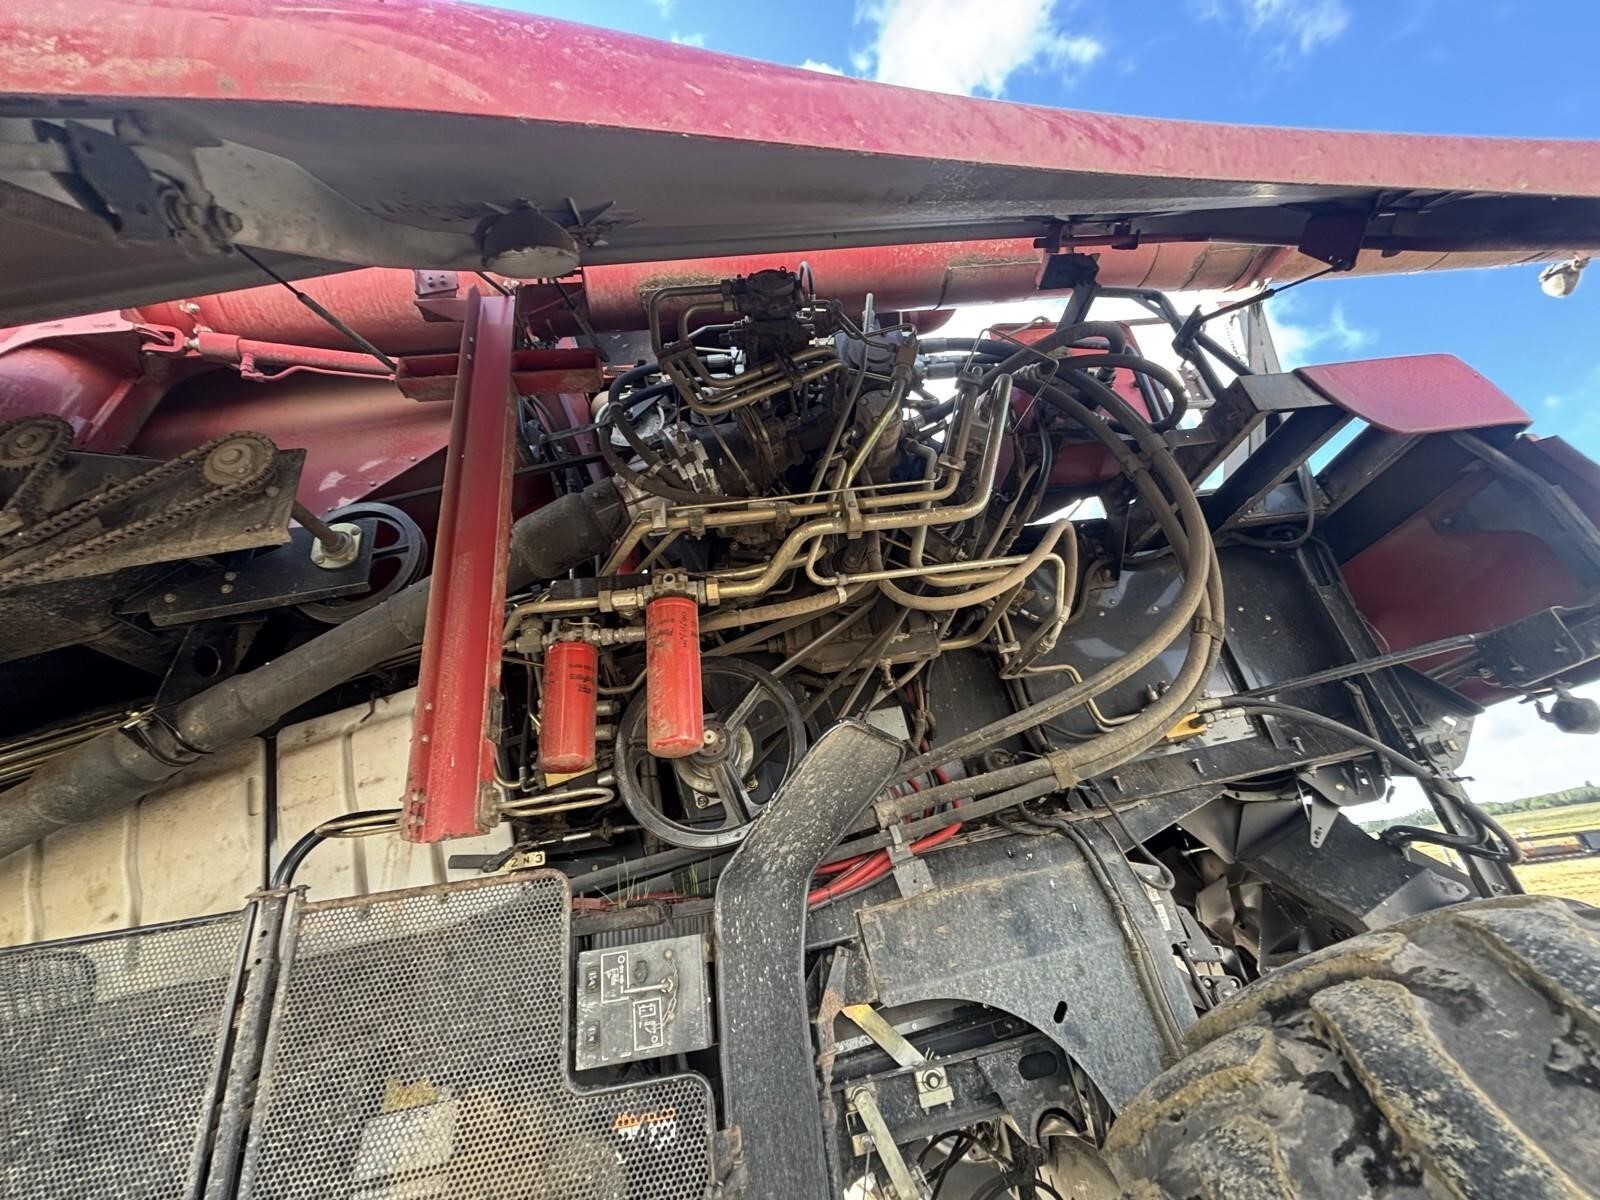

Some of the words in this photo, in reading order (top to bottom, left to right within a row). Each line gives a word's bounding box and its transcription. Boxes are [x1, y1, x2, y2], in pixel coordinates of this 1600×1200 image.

[510, 857, 519, 868] 2
[523, 855, 530, 864] N
[535, 853, 543, 863] 3
